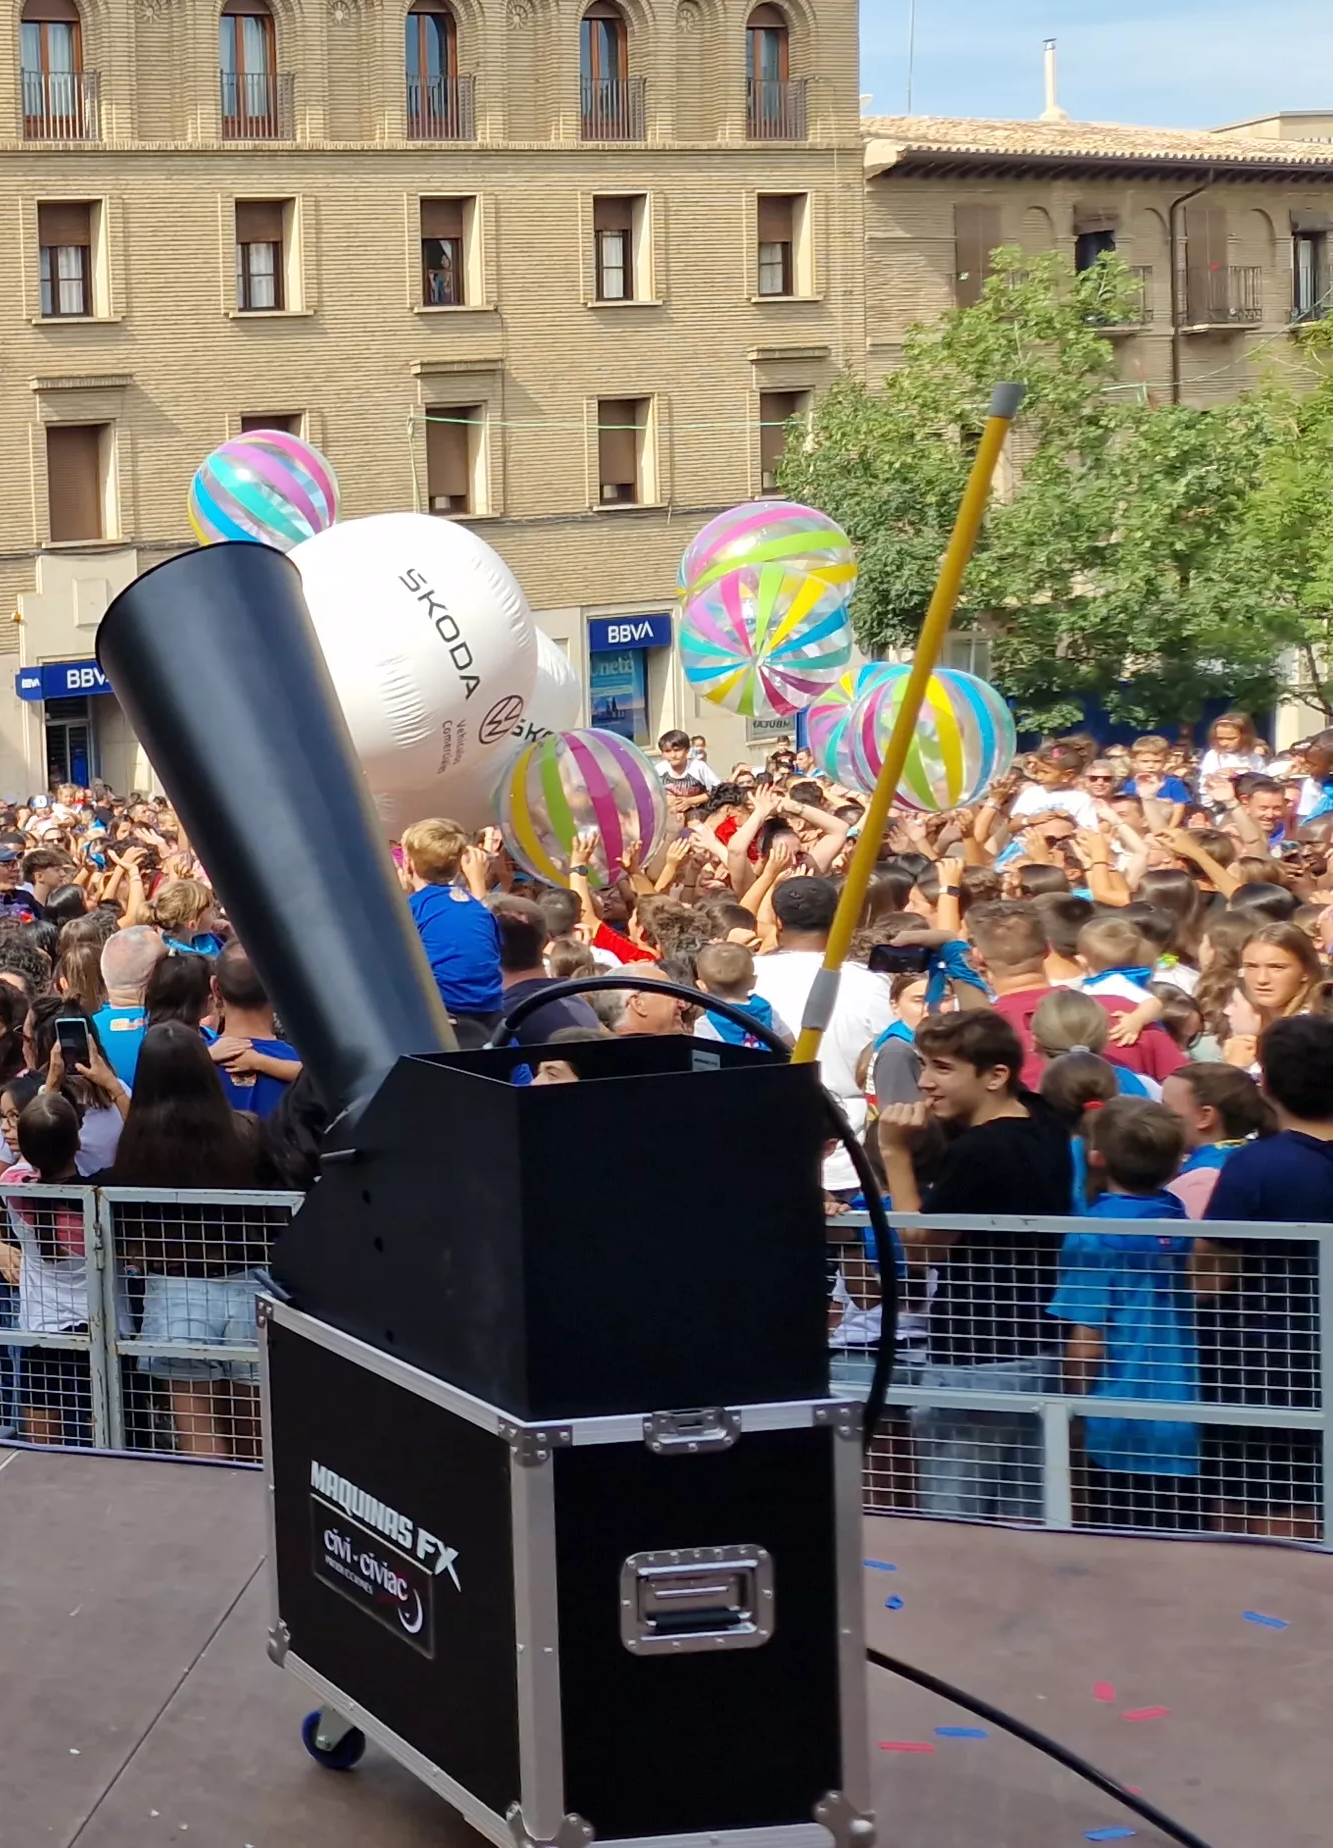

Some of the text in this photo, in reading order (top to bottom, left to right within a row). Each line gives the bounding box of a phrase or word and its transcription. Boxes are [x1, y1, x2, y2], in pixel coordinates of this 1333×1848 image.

[608, 621, 654, 643] BBVA
[66, 667, 109, 689] BBV
[311, 1459, 462, 1593] MAQUINAS FX
